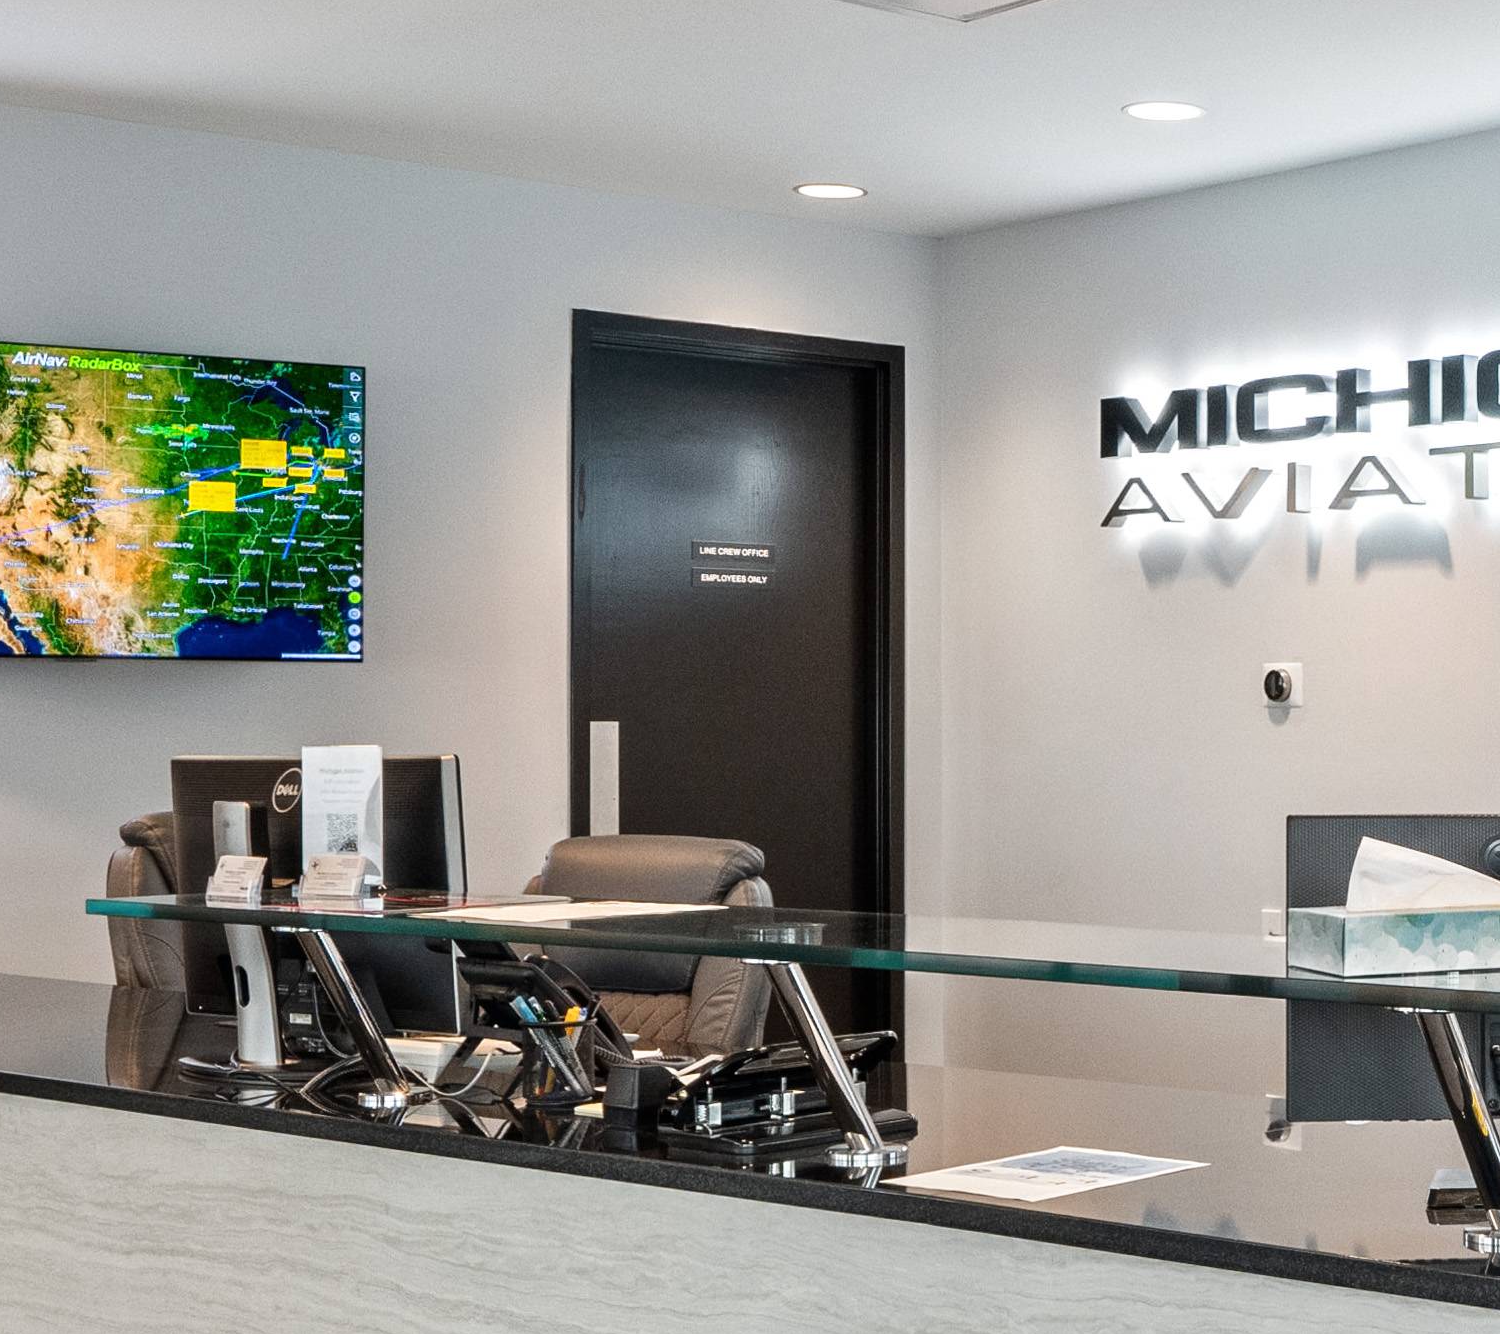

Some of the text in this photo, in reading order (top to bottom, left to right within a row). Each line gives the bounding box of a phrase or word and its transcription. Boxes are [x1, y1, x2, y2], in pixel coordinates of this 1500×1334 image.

[700, 546, 768, 558] LINE CREW OFFICE
[701, 574, 767, 585] EMPLOYEES ONLY
[276, 784, 299, 797] DELL
